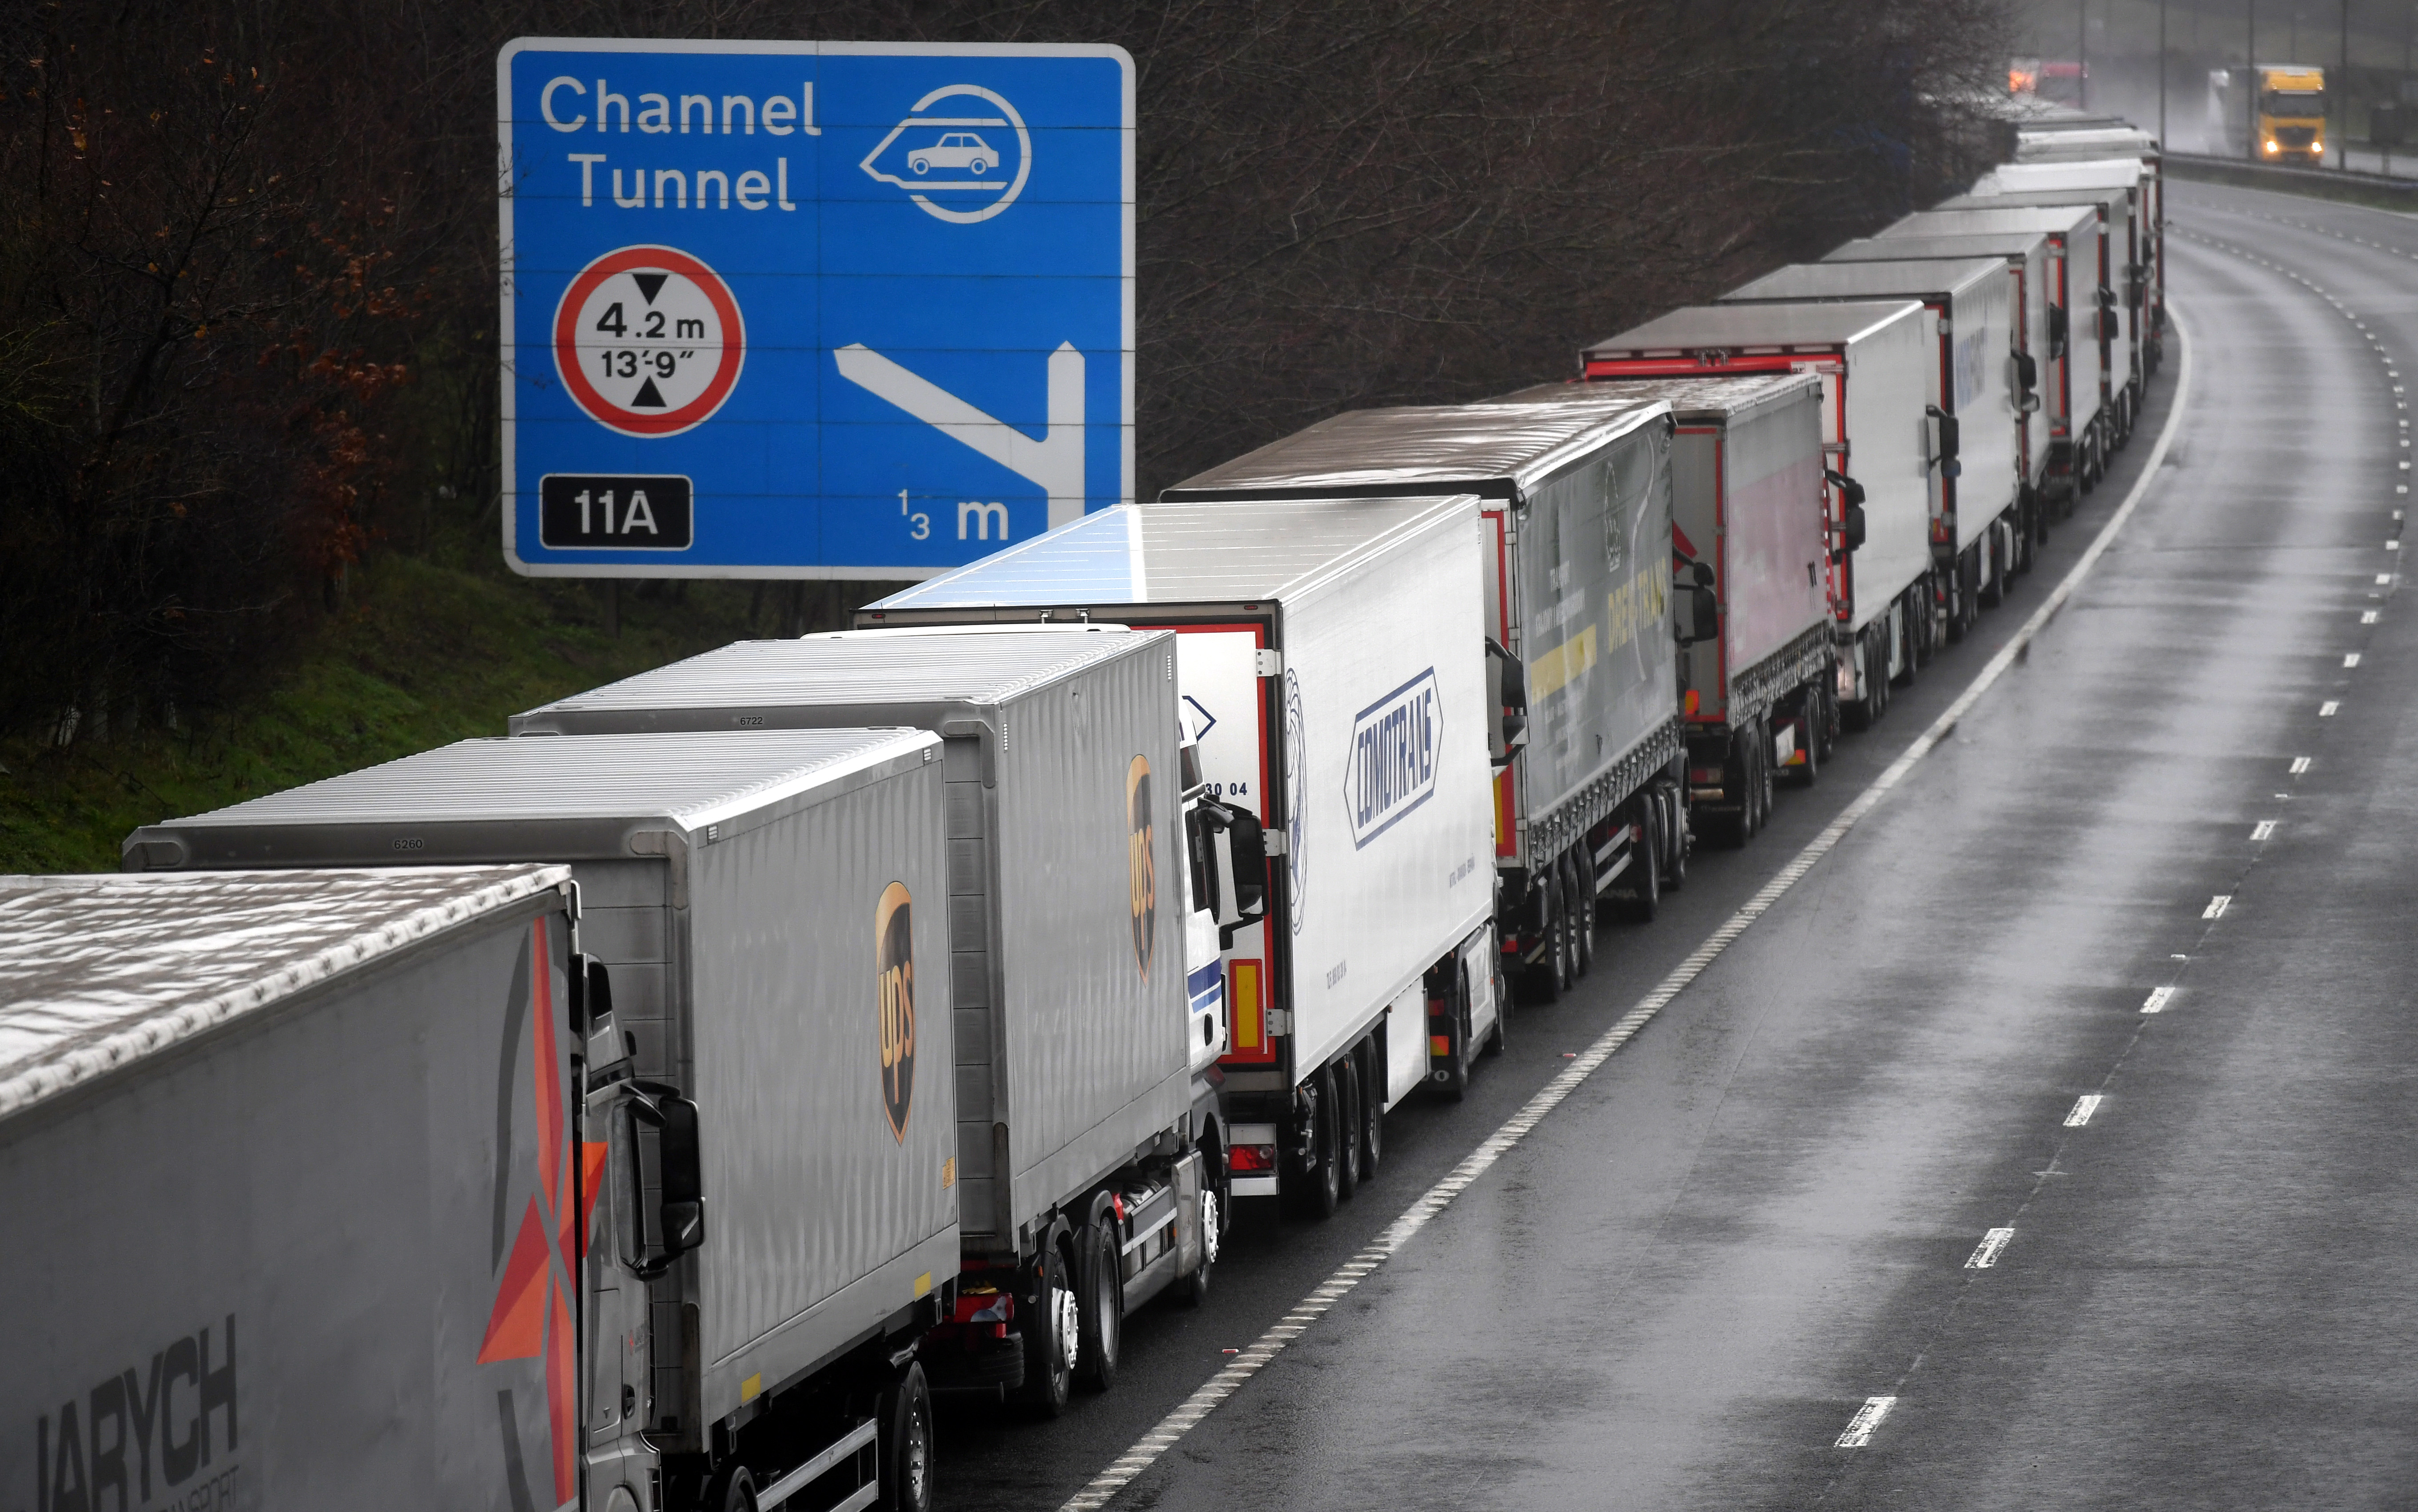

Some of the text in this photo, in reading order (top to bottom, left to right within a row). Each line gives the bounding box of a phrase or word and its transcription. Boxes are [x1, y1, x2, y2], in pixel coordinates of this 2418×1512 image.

[541, 76, 822, 136] Channel
[567, 153, 796, 211] Tunnel
[597, 302, 705, 338] 4.2 m
[574, 489, 659, 534] 11A
[958, 501, 1009, 540] m
[740, 716, 763, 725] 6722
[1357, 687, 1432, 830] COMOTRANS
[1230, 782, 1247, 796] 04
[394, 840, 423, 849] 6260
[1130, 824, 1154, 951] ups
[880, 960, 913, 1105] ups
